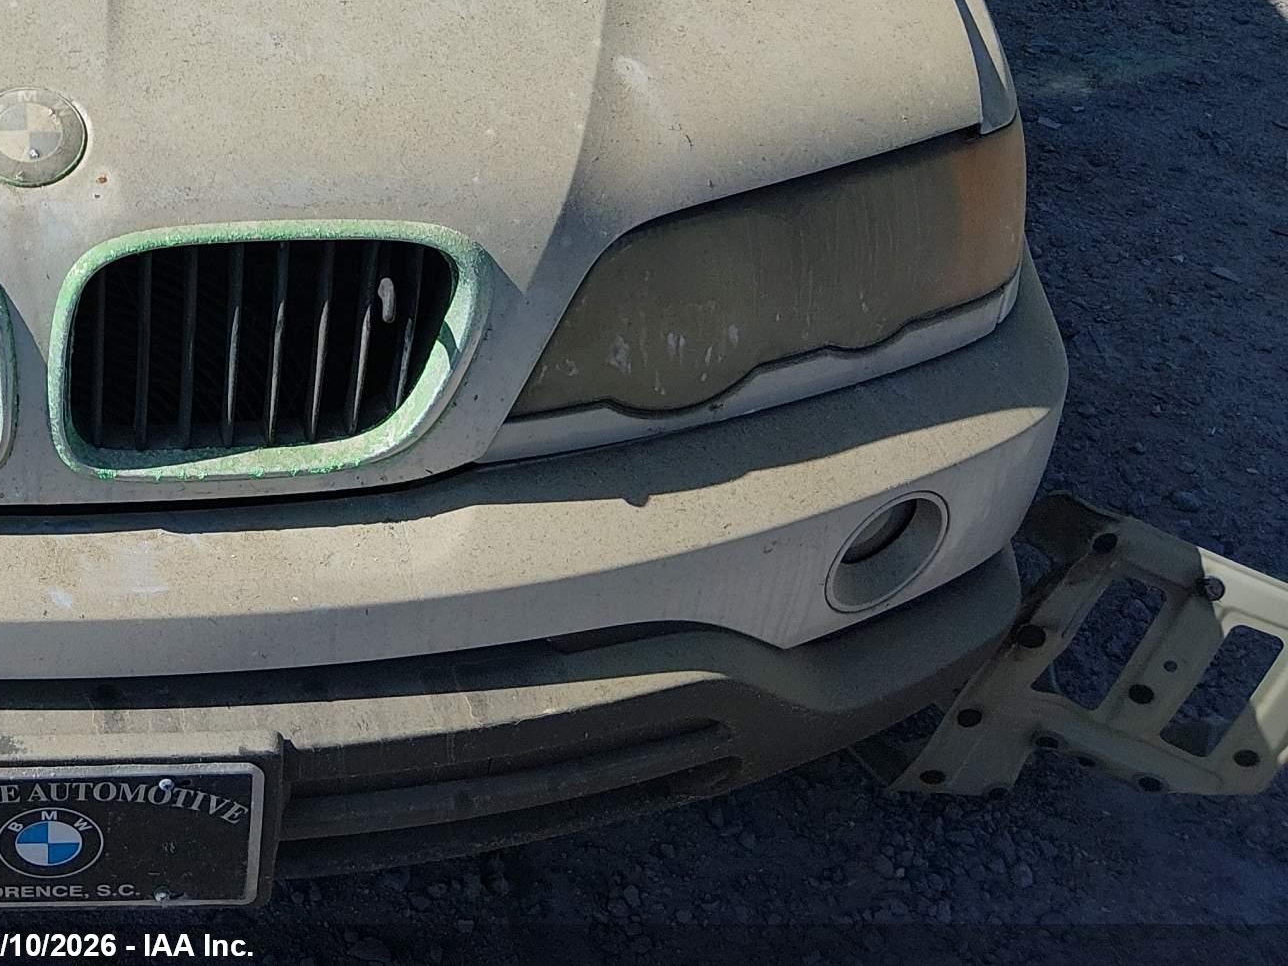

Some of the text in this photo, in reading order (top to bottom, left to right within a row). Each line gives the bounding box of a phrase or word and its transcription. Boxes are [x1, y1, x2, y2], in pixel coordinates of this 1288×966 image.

[27, 782, 249, 824] AUTOMOTIVE
[7, 810, 92, 833] BMW
[97, 884, 140, 898] S.C.
